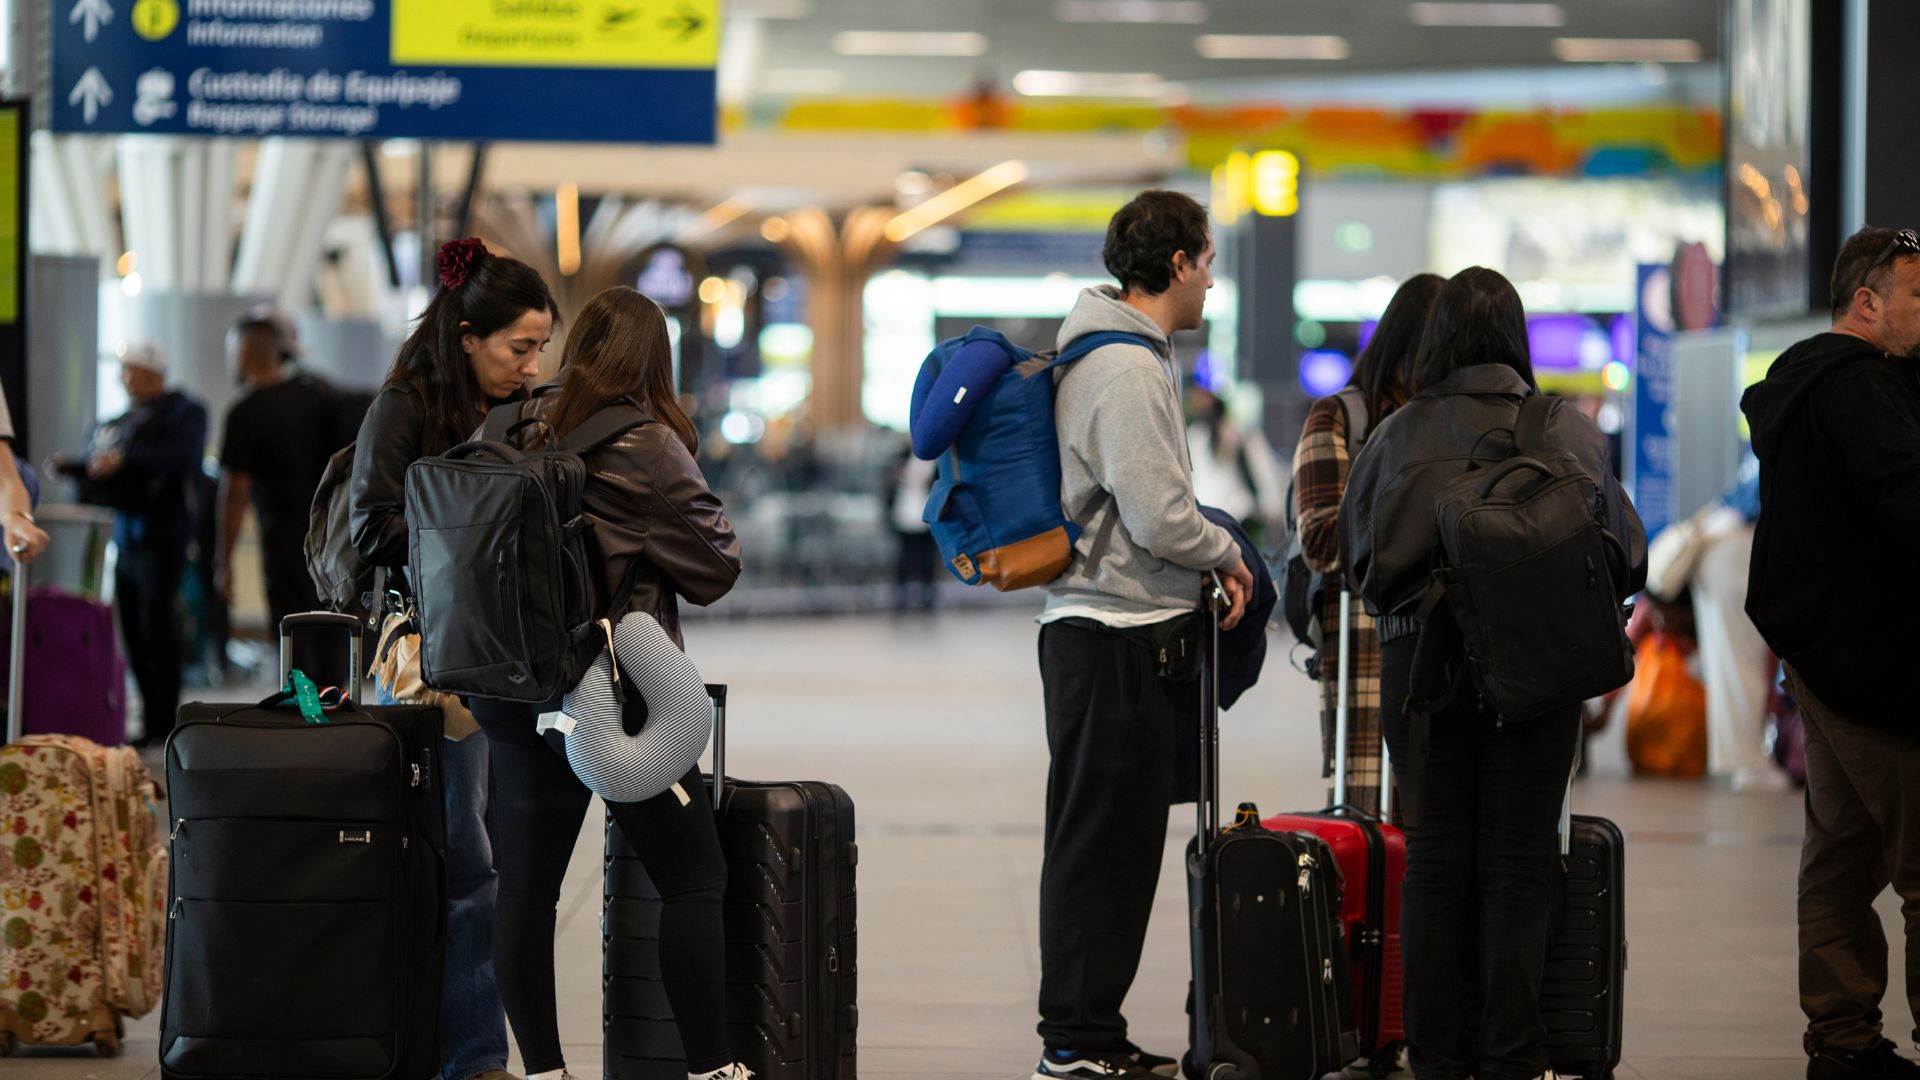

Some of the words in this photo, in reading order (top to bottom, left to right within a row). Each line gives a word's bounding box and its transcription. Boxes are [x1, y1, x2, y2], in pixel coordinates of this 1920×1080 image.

[187, 18, 323, 48] Information
[188, 68, 304, 100] Custodia
[305, 69, 343, 100] de
[344, 71, 462, 109] Equipaje
[287, 102, 379, 135] Storage
